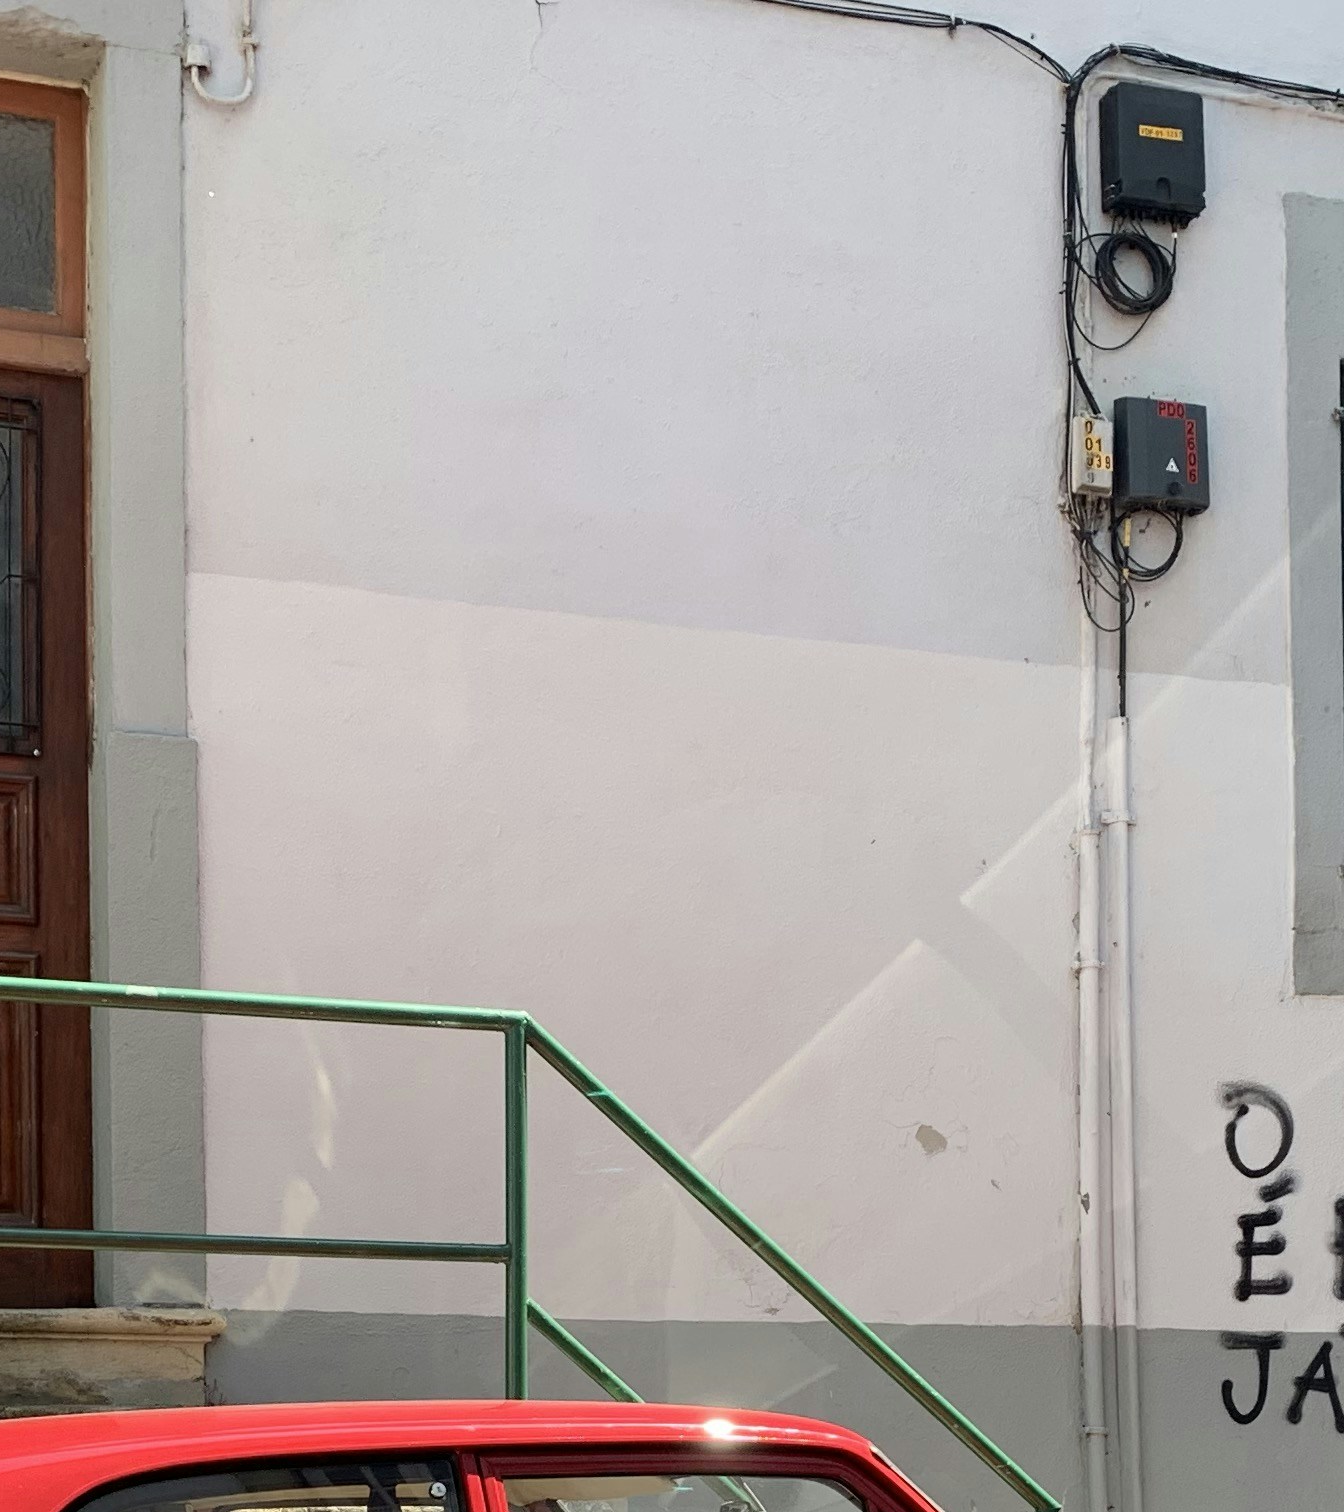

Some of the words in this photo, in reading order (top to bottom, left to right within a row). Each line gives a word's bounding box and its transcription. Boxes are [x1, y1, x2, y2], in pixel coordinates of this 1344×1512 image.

[1186, 421, 1197, 483] 2606
[1219, 1079, 1294, 1179] O
[1234, 1171, 1298, 1301] É
